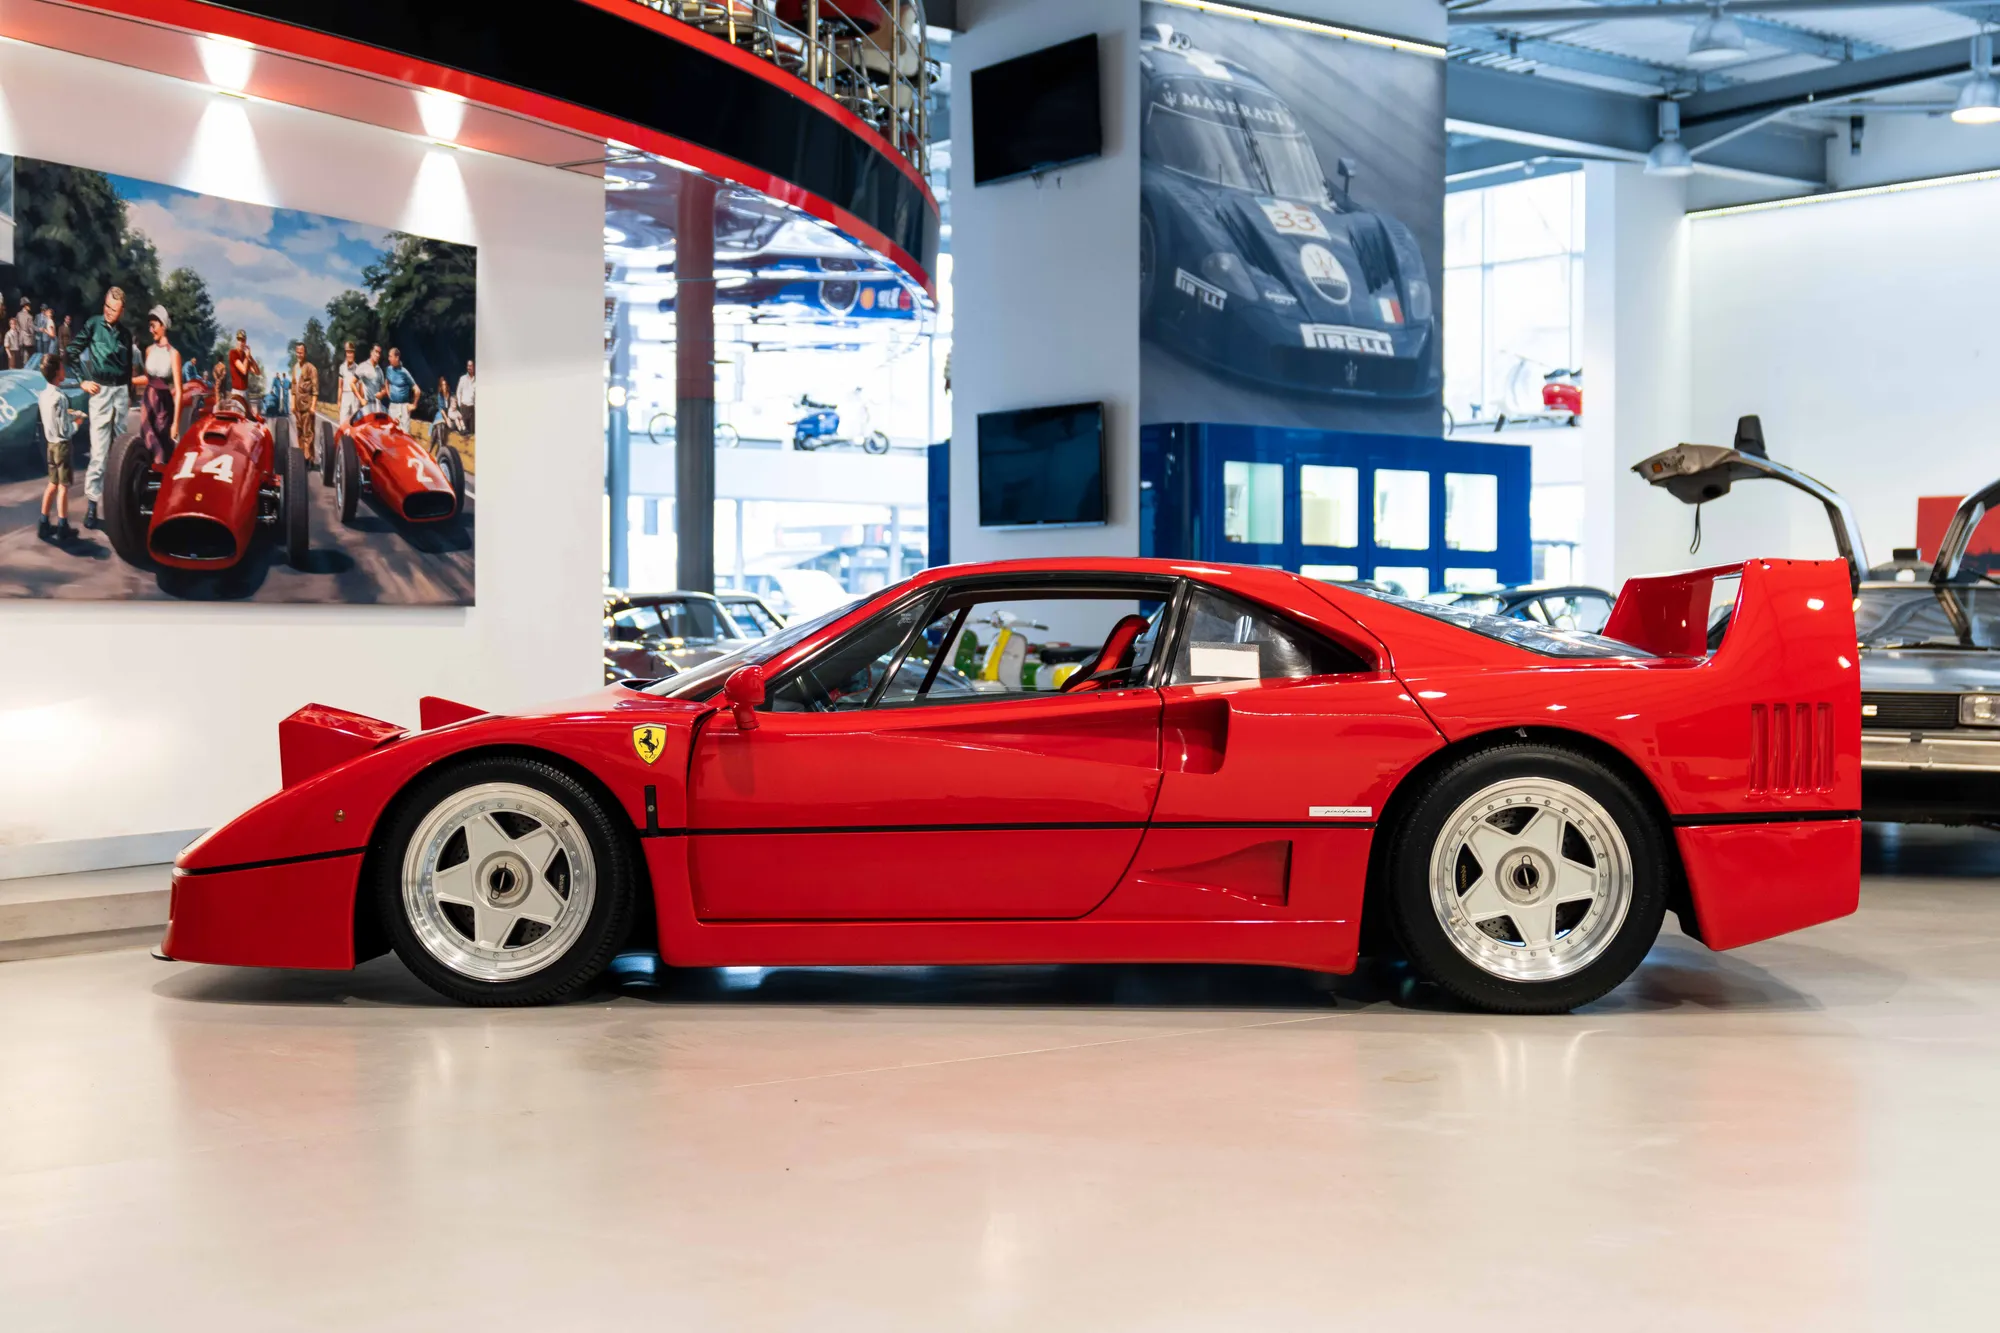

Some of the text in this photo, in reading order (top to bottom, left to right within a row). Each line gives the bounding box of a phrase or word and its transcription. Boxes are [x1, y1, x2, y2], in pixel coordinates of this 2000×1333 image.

[1181, 92, 1284, 125] MASERATI
[1273, 209, 1316, 231] 33
[1175, 267, 1227, 311] PIRLLI
[1300, 323, 1395, 357] PIRELLI
[172, 451, 234, 484] 14
[407, 457, 433, 483] 2
